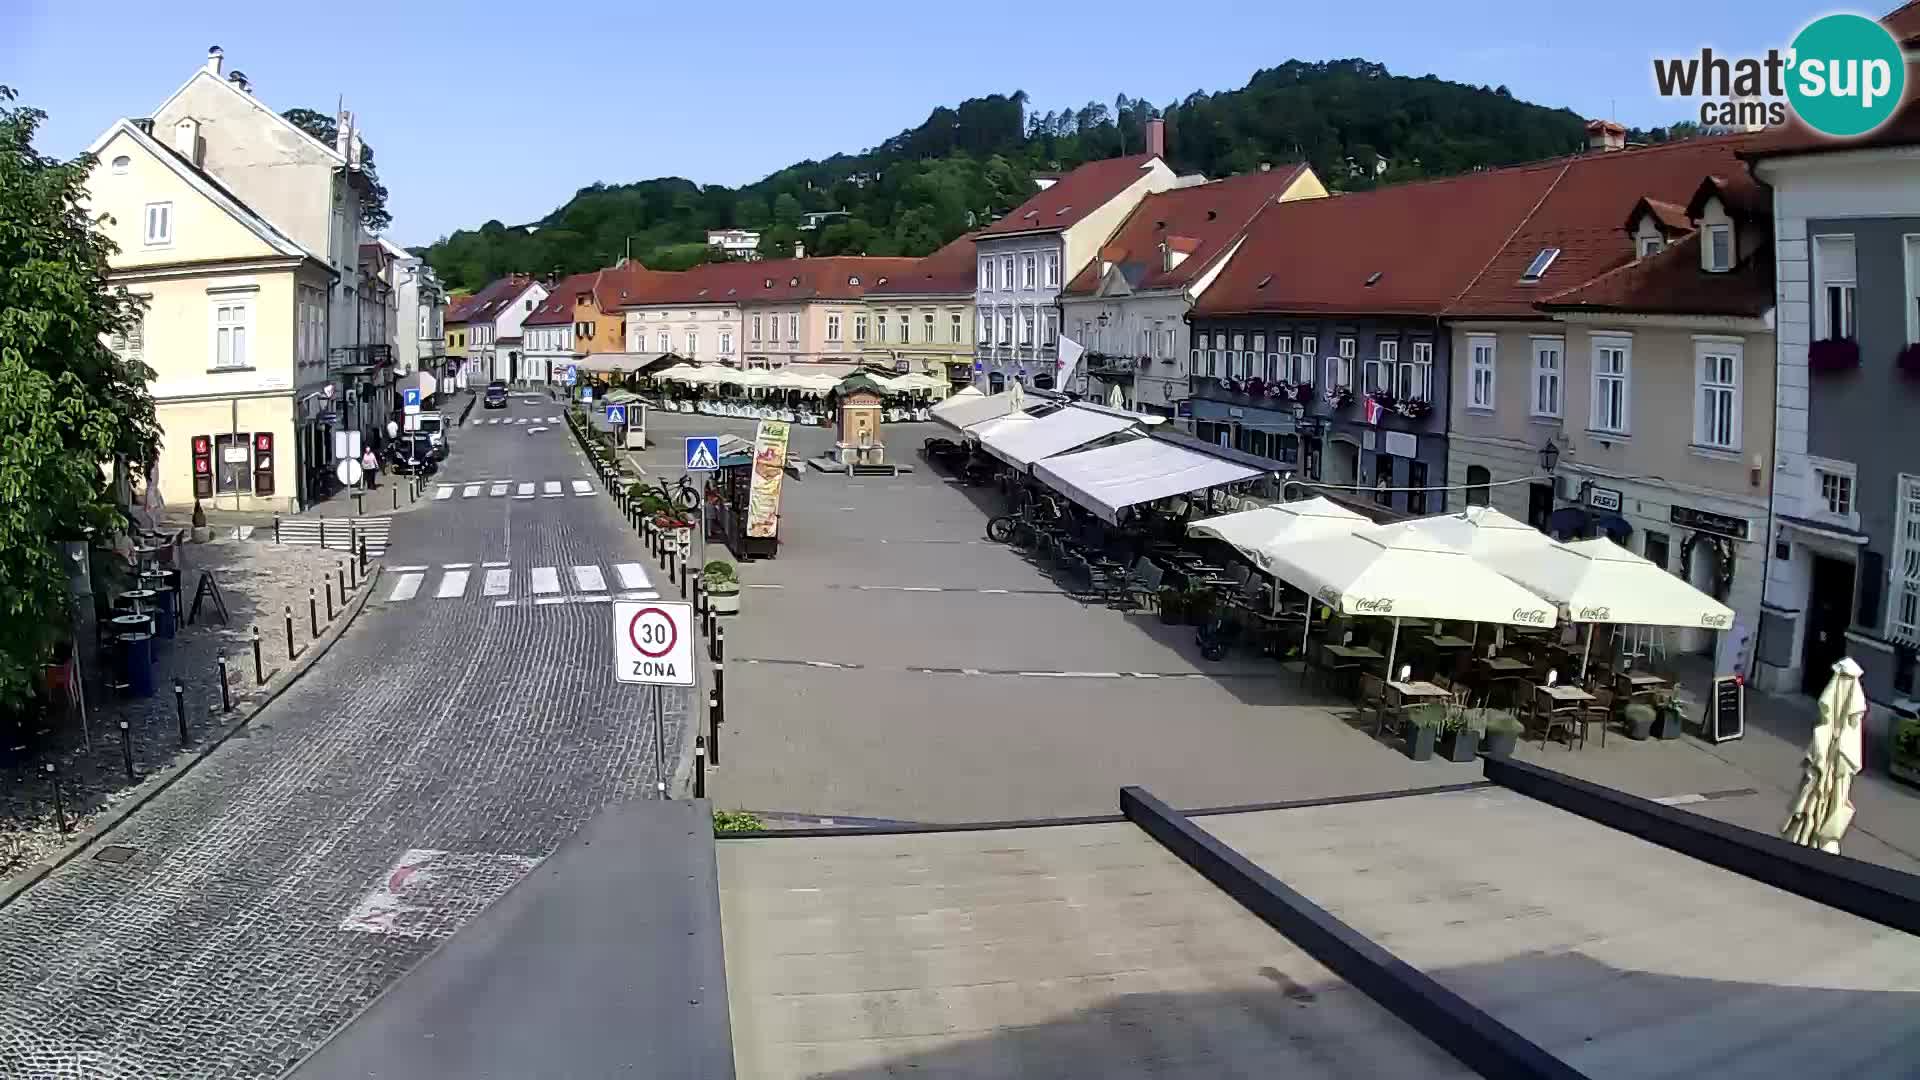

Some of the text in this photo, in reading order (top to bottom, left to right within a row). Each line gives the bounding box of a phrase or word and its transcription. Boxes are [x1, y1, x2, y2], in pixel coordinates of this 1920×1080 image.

[408, 392, 416, 403] P
[642, 624, 665, 644] 30
[633, 661, 676, 677] ZONA
